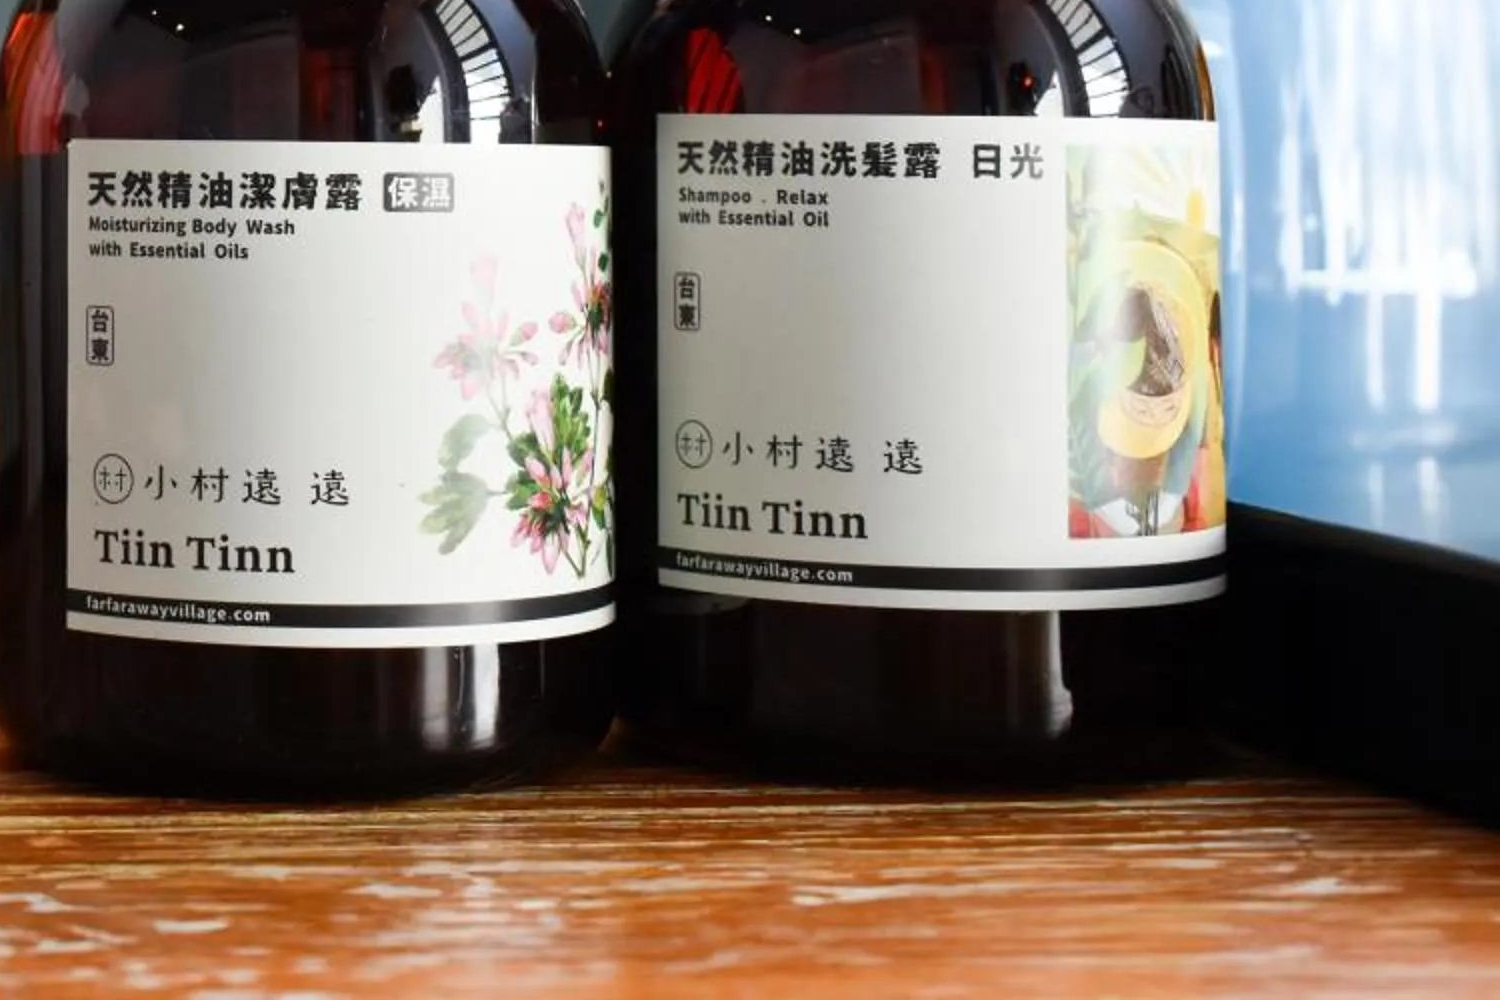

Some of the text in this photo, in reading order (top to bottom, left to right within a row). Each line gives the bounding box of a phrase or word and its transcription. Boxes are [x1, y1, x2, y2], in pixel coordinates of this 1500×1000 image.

[677, 140, 1044, 179] 天然精油洗髮露 日光
[88, 171, 362, 211] 天然精油潔膚露
[678, 187, 752, 206] Shampoo
[776, 189, 829, 206] Relax
[89, 217, 295, 238] Moisturizing Body Wash
[679, 208, 829, 227] with Essential Oil
[89, 242, 249, 260] with Essential Oils
[677, 492, 869, 539] Tiin Tinn
[95, 528, 295, 573] Tiin Tinn
[676, 552, 853, 583] farfarawayvillage.com
[87, 595, 271, 623] farfarawayvillage.com
